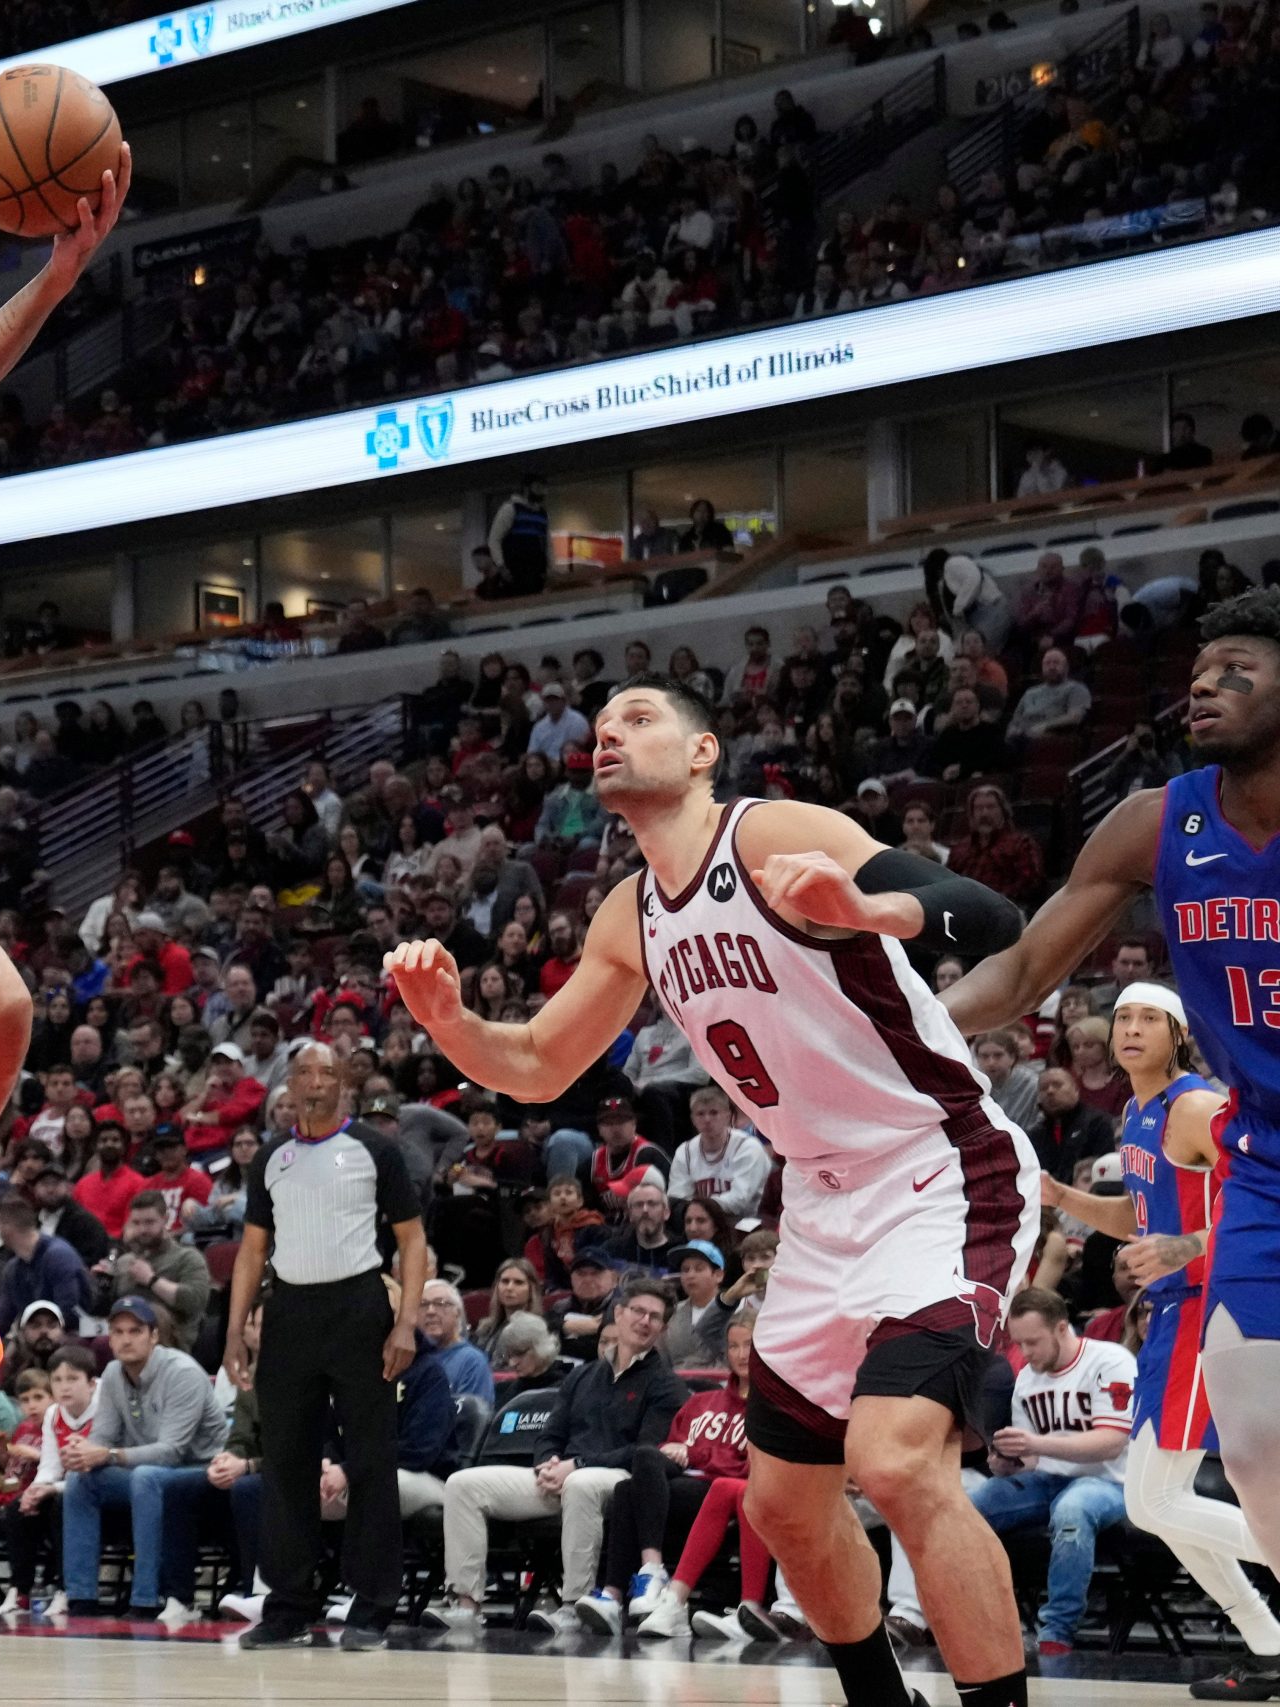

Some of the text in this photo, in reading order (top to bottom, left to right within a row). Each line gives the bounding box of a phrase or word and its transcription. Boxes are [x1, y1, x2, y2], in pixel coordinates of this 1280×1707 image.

[471, 341, 854, 432] BlueCross BlueShield of Illinois
[1184, 814, 1201, 834] 6
[659, 933, 778, 1029] CICAGO
[1225, 966, 1280, 1029] 13
[706, 1019, 779, 1108] 9
